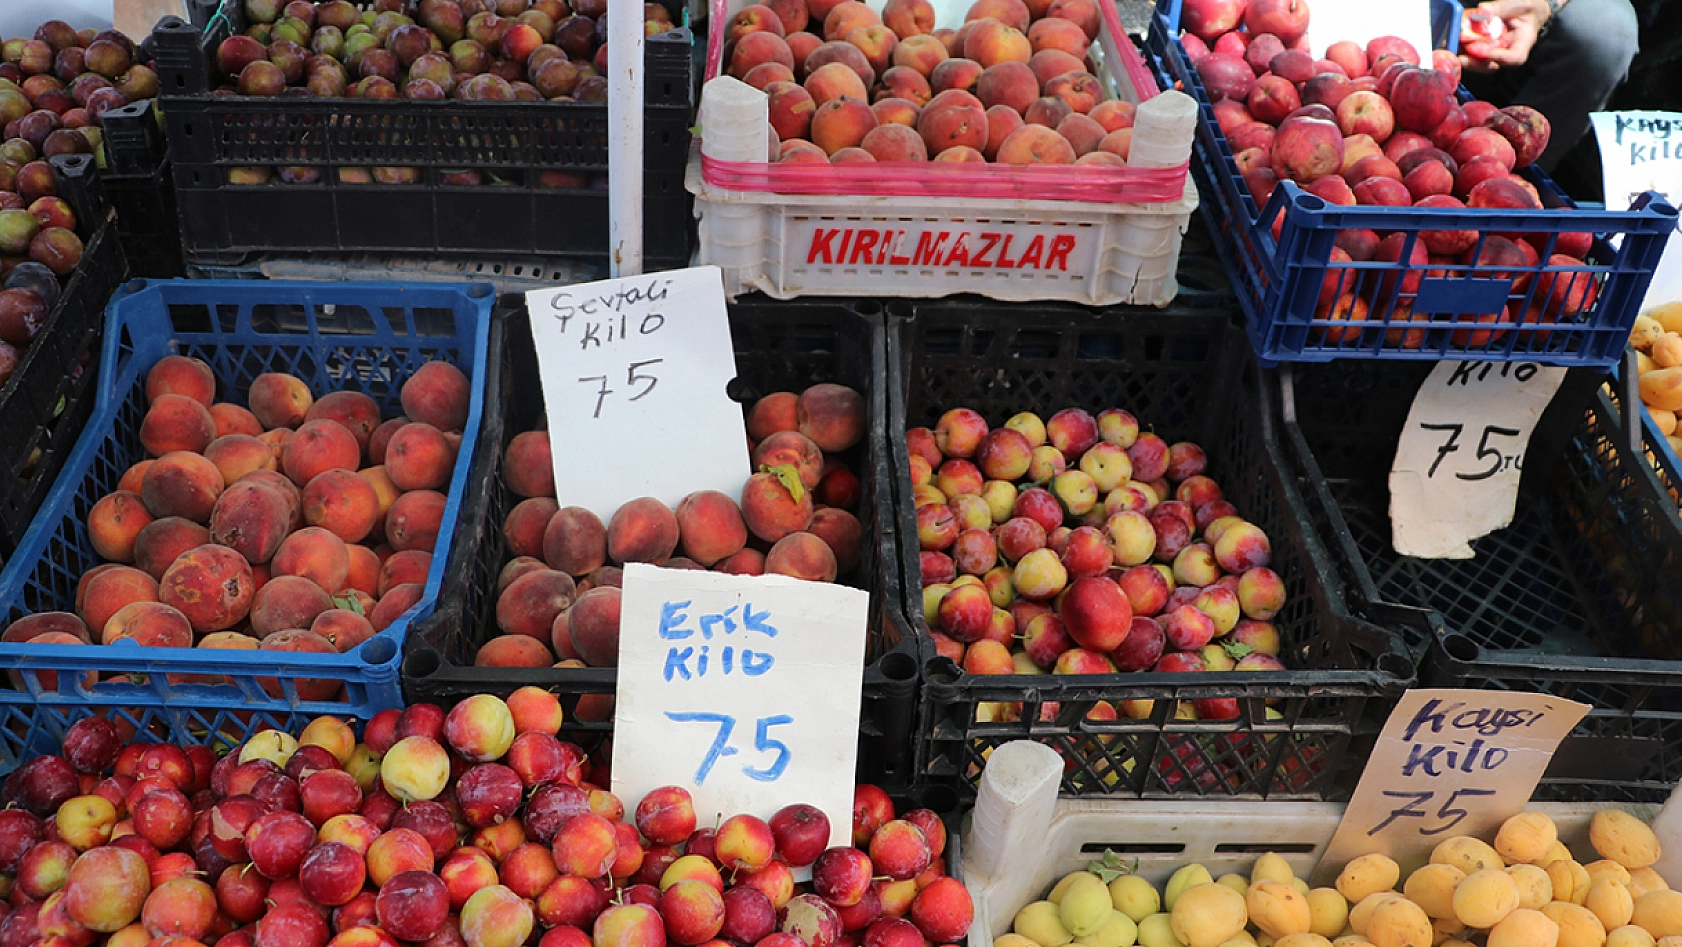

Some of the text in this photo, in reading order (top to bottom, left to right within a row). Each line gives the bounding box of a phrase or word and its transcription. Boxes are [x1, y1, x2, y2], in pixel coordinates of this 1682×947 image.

[806, 228, 1076, 272] KIRILMAZLAR
[578, 358, 664, 418] 75
[659, 600, 779, 640] Erik
[663, 711, 794, 786] 75
[1367, 789, 1497, 836] 75
